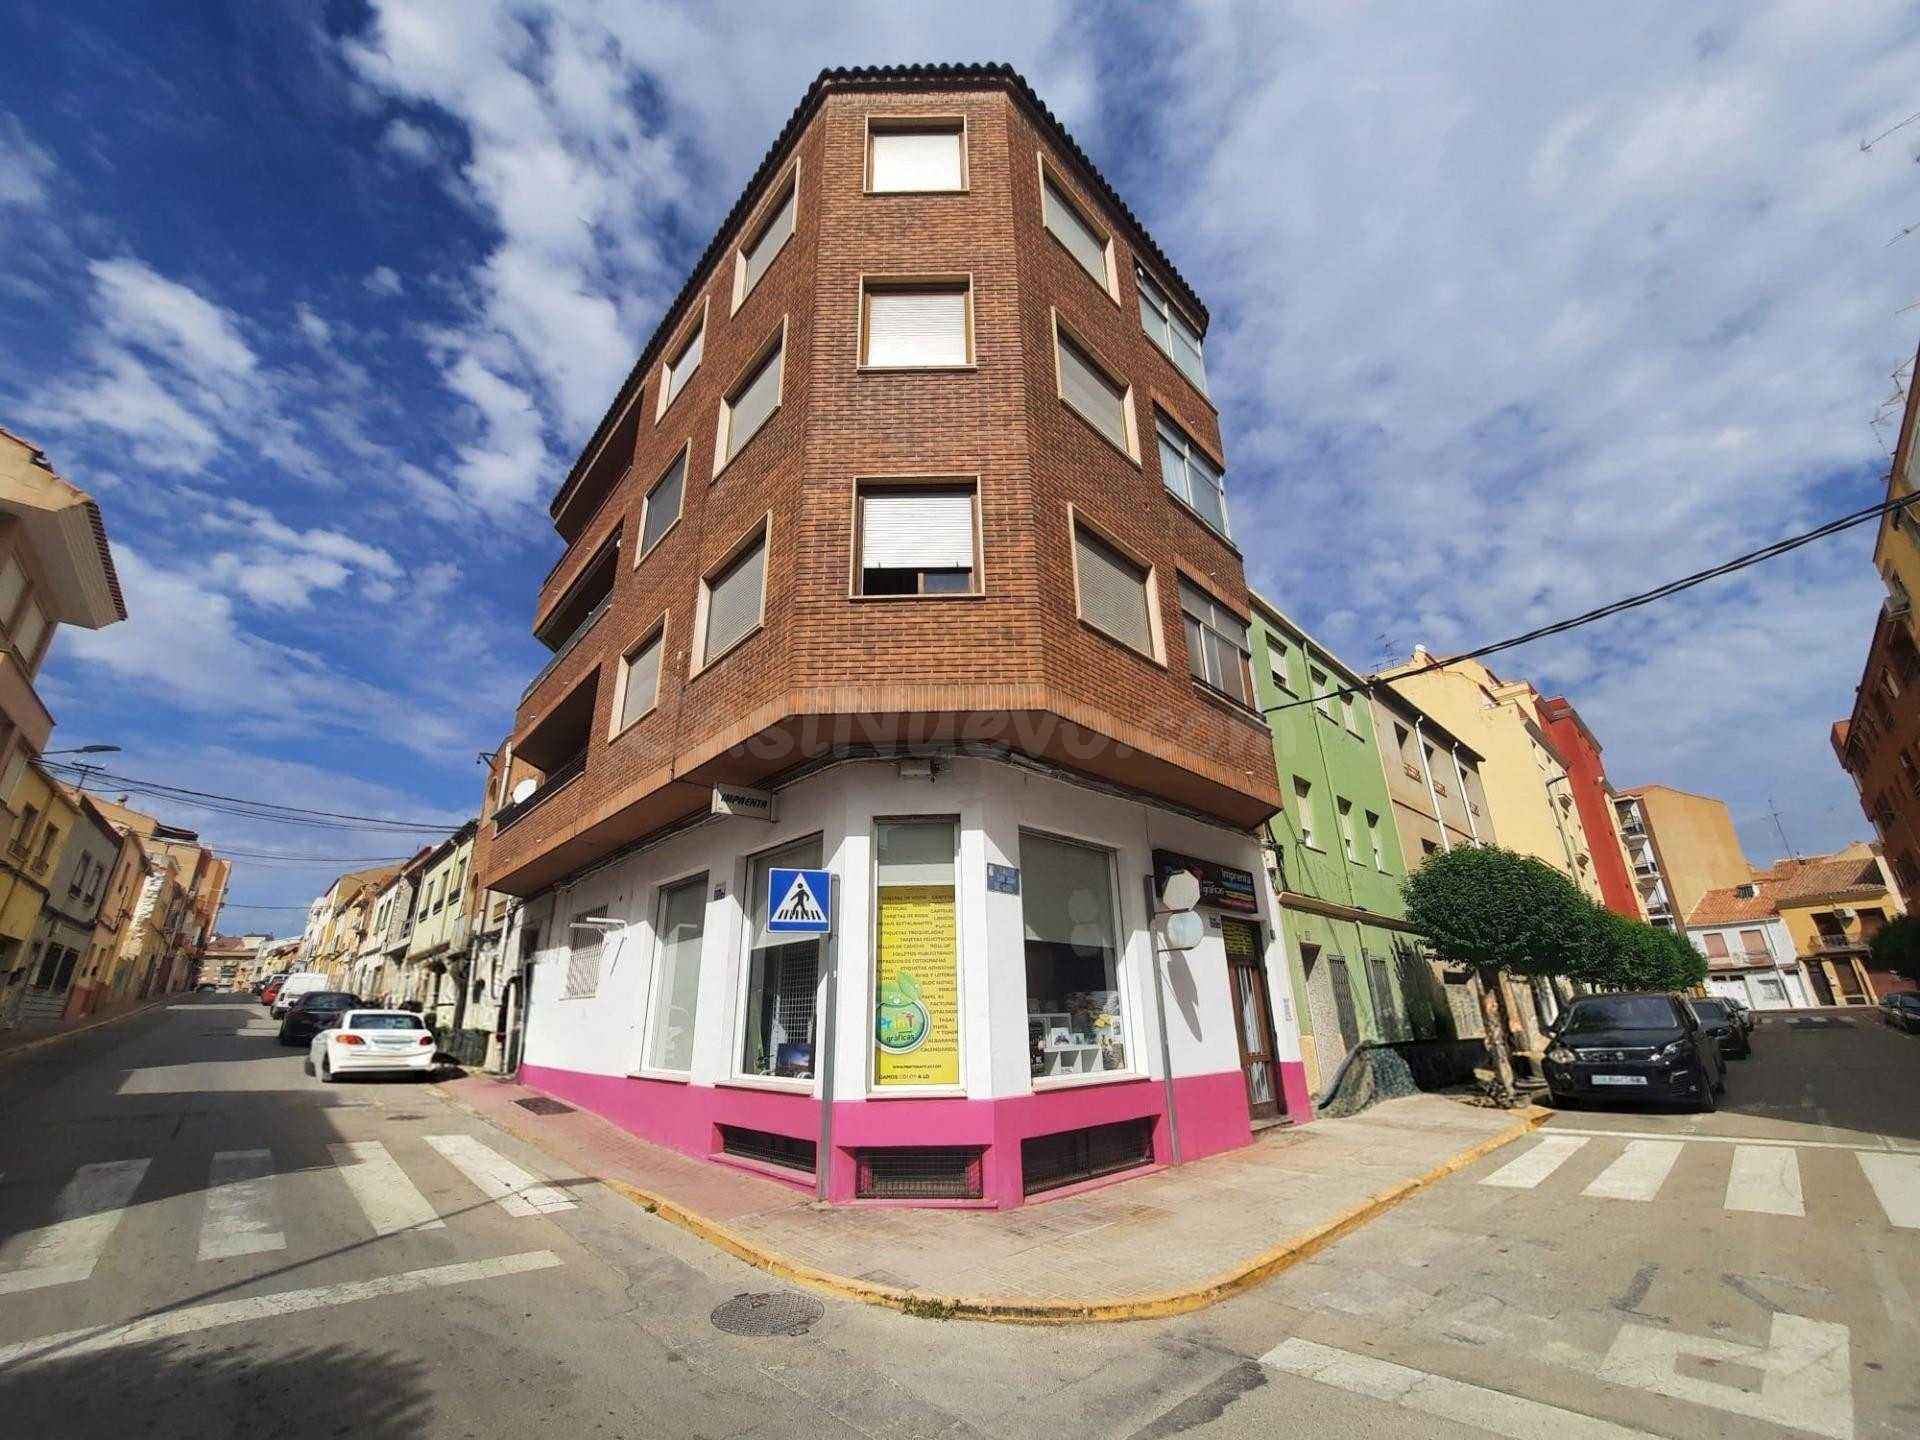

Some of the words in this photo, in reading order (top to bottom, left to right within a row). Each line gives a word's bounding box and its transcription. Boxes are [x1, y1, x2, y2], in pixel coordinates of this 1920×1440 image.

[720, 792, 769, 809] IMPRENTA
[1220, 867, 1252, 884] Imprenta
[886, 1034, 916, 1043] gráficas
